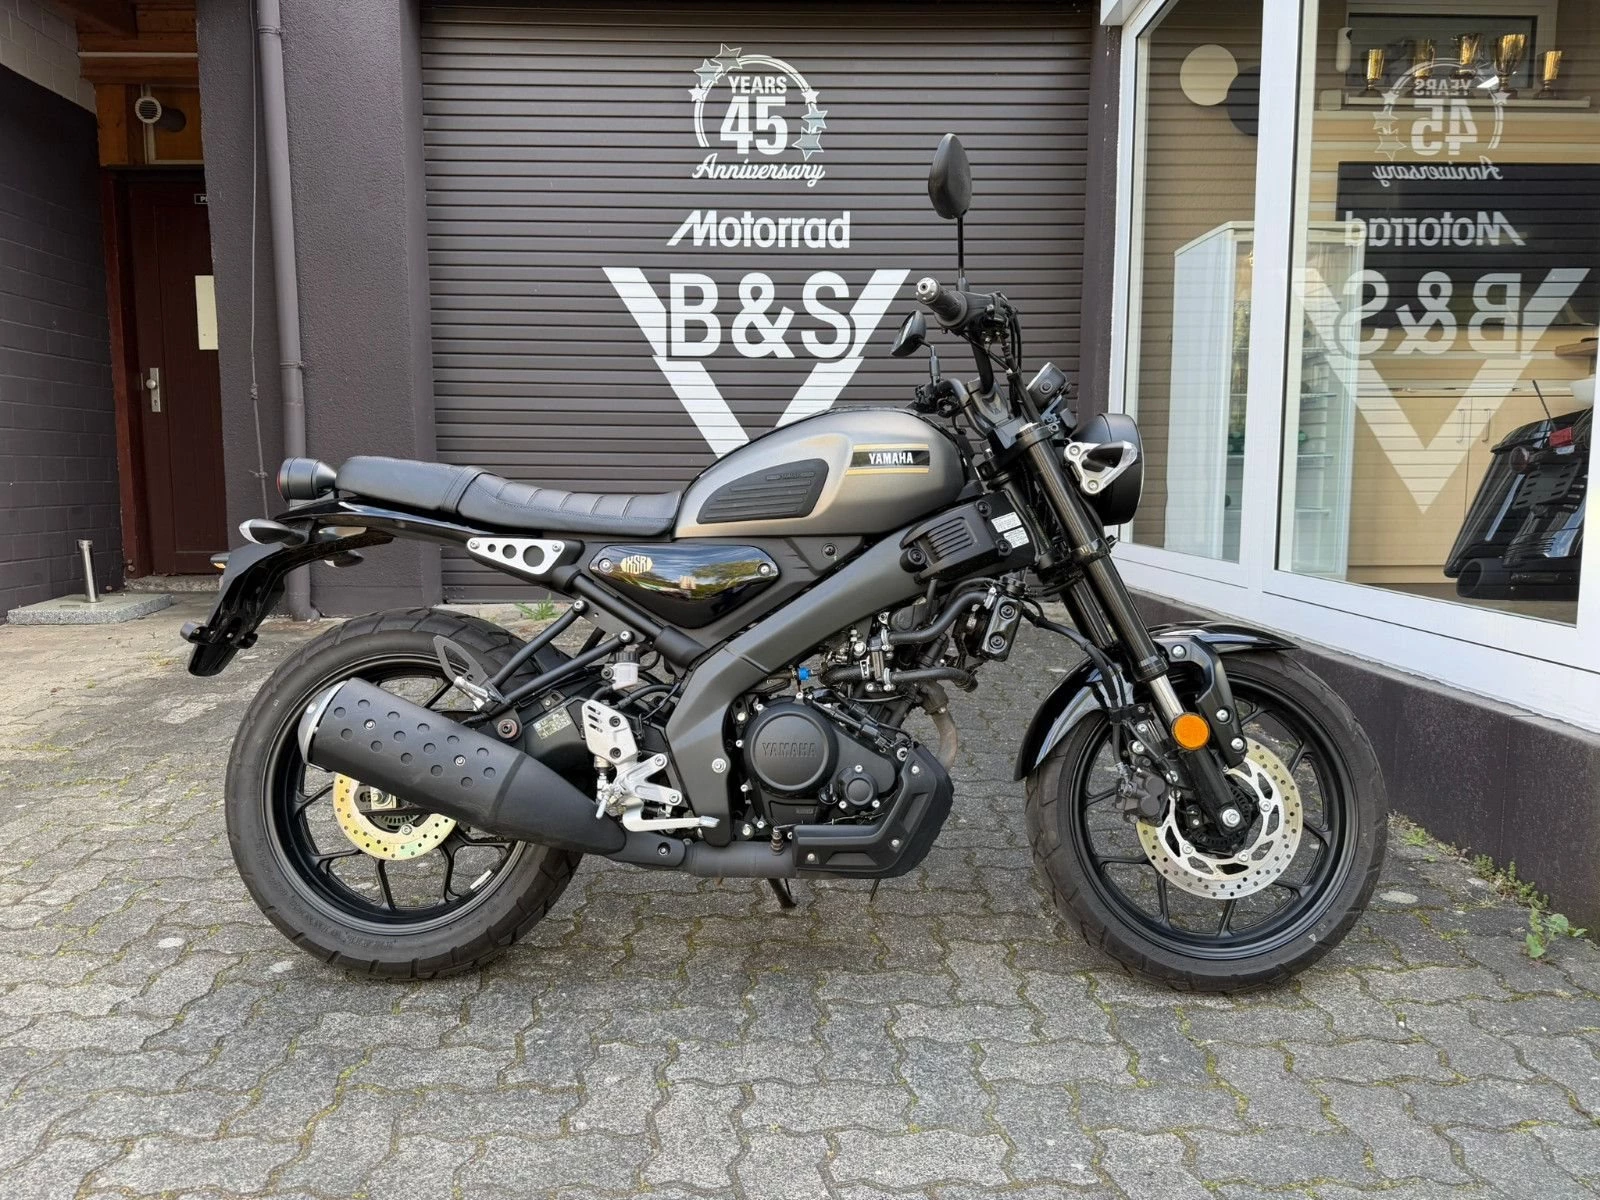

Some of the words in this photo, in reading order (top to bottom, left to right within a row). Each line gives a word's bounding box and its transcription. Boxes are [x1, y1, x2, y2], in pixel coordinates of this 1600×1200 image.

[728, 76, 787, 95] YEARS
[720, 96, 789, 155] 45
[692, 153, 826, 187] Anniversary
[666, 210, 850, 249] Motorrad
[670, 271, 851, 358] B&S
[869, 452, 914, 465] YAMAHA
[626, 555, 648, 575] XSR
[761, 742, 817, 758] YAMAHA
